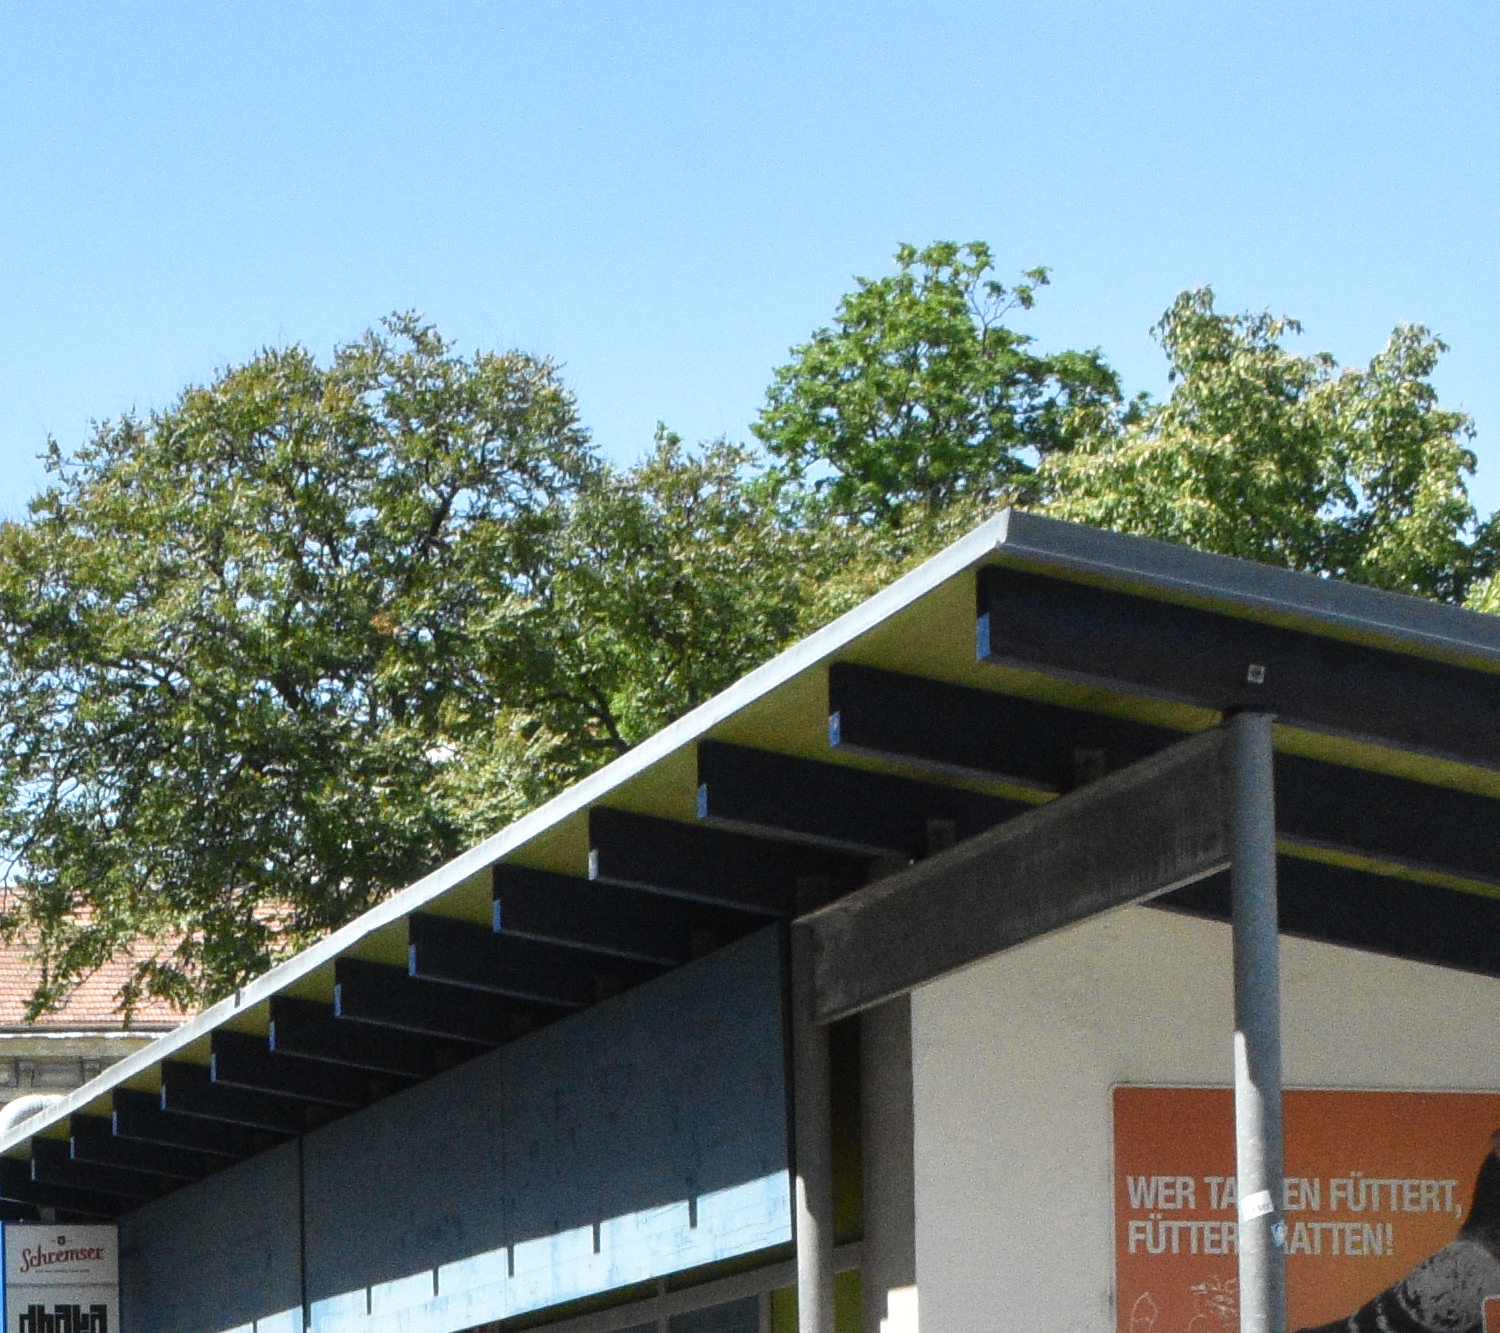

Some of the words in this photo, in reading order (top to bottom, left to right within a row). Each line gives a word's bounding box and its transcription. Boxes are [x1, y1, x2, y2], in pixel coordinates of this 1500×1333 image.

[1126, 1176, 1195, 1211] WER
[1203, 1177, 1319, 1213] TAEN
[1329, 1171, 1462, 1218] FÜTTERT,
[1128, 1214, 1240, 1256] FÜTTER
[1283, 1221, 1394, 1256] ATTEN!
